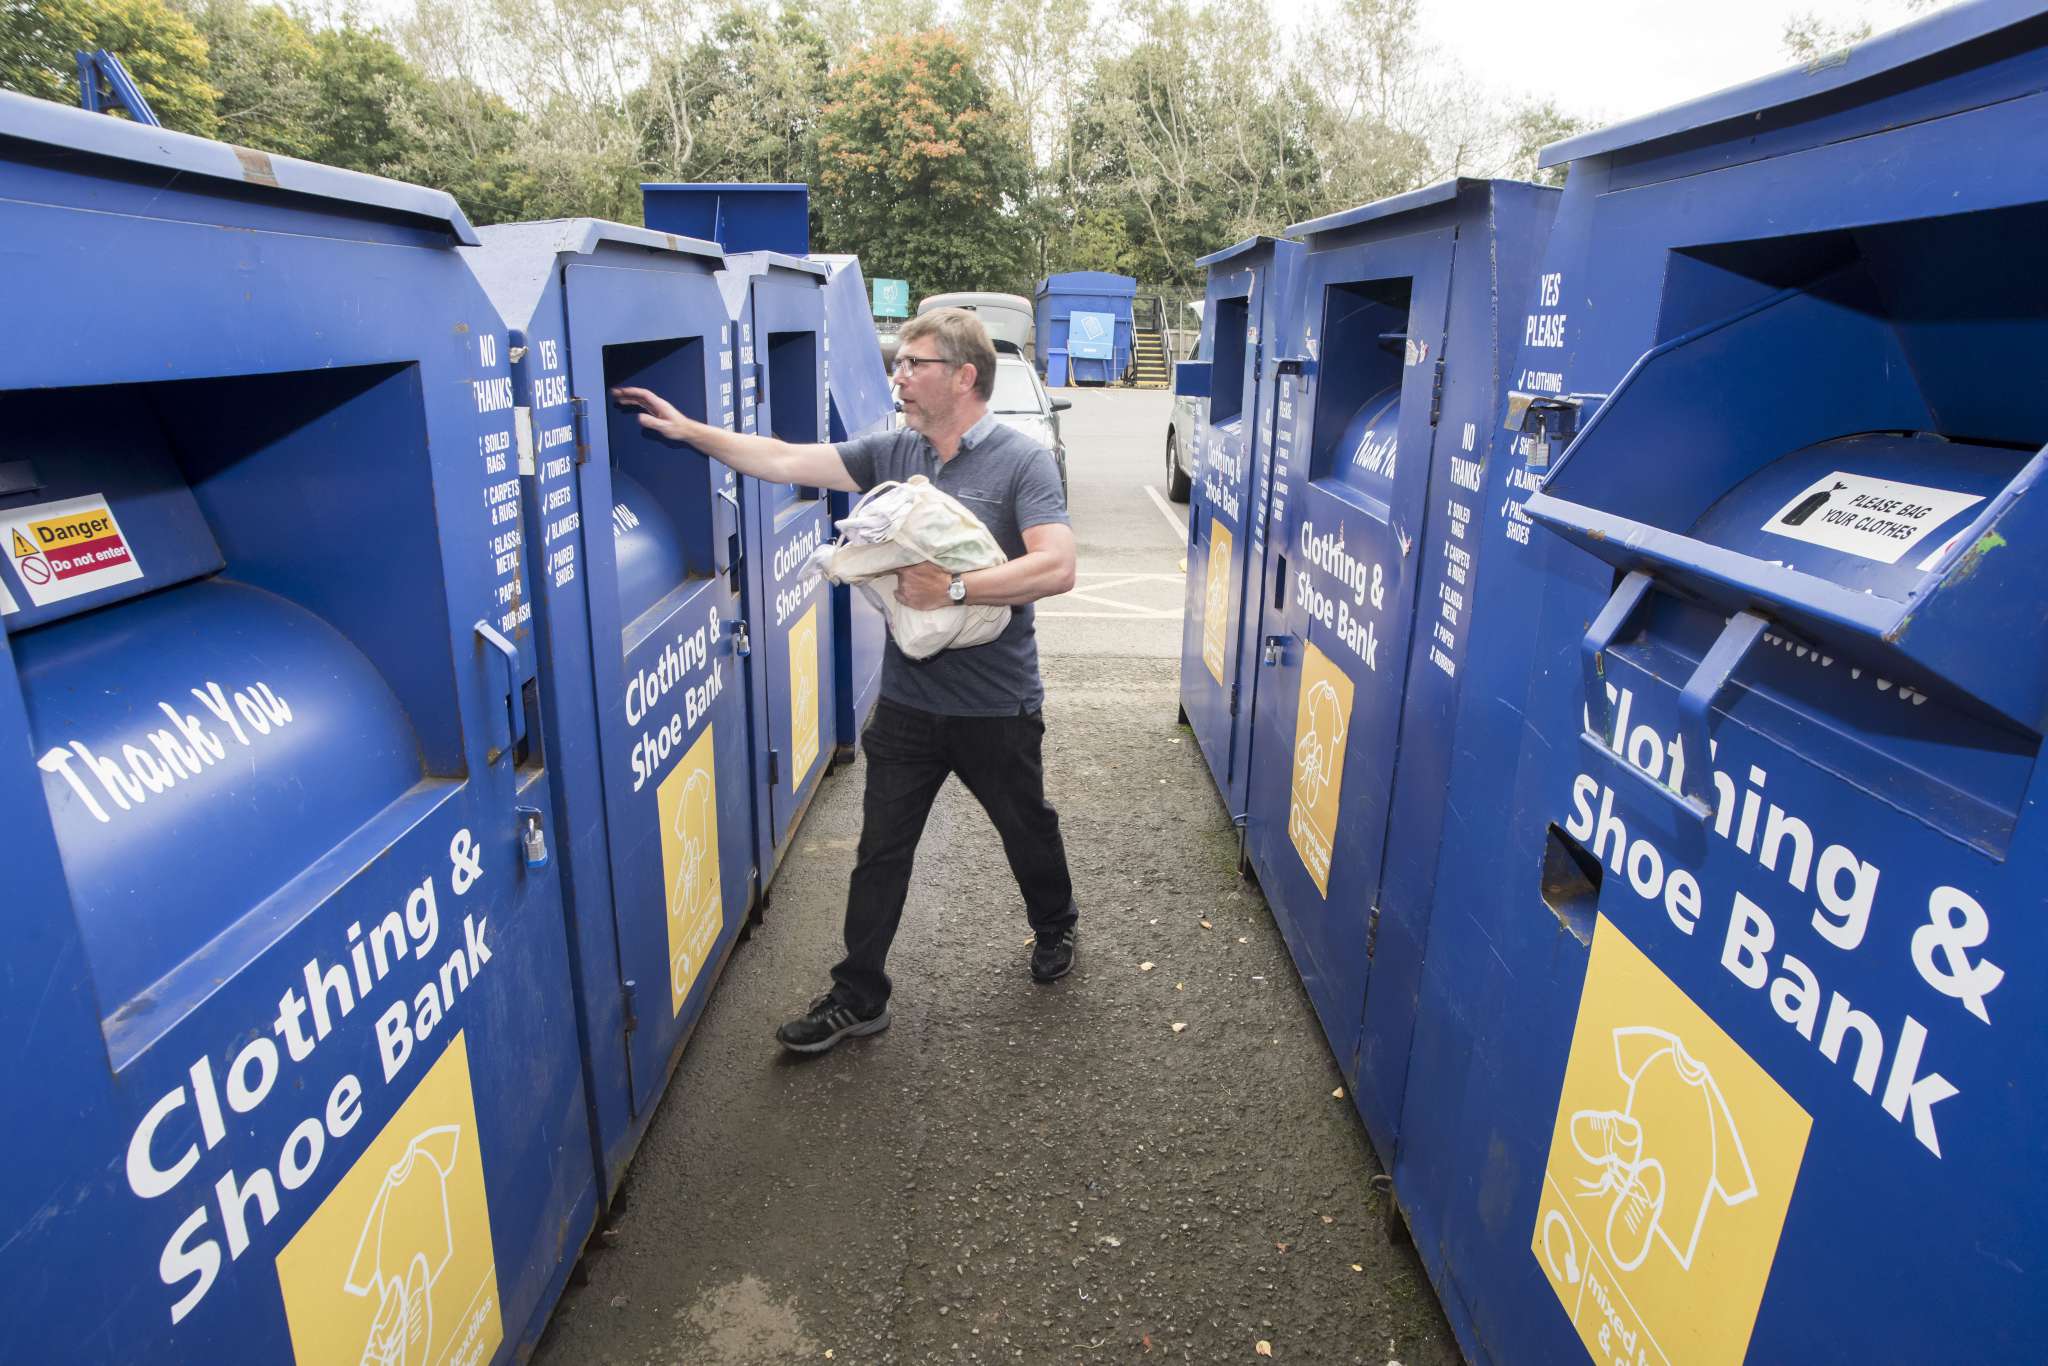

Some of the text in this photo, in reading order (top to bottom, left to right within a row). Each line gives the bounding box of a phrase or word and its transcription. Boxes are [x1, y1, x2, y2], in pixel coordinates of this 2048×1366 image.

[1540, 272, 1561, 307] YES
[1525, 314, 1567, 348] PLEASE
[479, 333, 497, 368] NO
[539, 339, 557, 371] YES
[534, 375, 568, 410] PLEASE
[1527, 370, 1562, 393] CLOTHING
[485, 431, 510, 454] SOILED
[544, 424, 573, 449] CLOTHING
[1462, 422, 1475, 452] NO
[486, 452, 506, 476] RAGS
[547, 455, 571, 479] TOWELS
[1450, 455, 1481, 493] THANKS
[489, 478, 520, 505] CARPETS
[549, 486, 571, 510] SHEETS
[1223, 484, 1239, 523] Bank
[1848, 493, 1932, 520] PLEASE BAG
[491, 500, 518, 526] & RUGS
[551, 511, 580, 540] BLANKETS
[1453, 502, 1471, 524] SOILED
[1821, 508, 1917, 540] YOUR CLOTHES
[37, 517, 109, 543] Danger
[1451, 519, 1465, 540] RAGS
[1506, 520, 1530, 545] SHOES
[50, 546, 127, 572] Do not enter
[496, 551, 520, 576] METAL
[553, 544, 574, 570] PAIRED
[774, 518, 821, 582] Clothing &
[1301, 520, 1367, 607] Clothing
[1370, 563, 1385, 611] &
[555, 562, 575, 588] SHOES
[776, 583, 801, 627] Shoe
[1297, 569, 1379, 672] Shoe Bank
[625, 605, 721, 727] Clothing &
[631, 656, 724, 793] Shoe Bank
[36, 681, 293, 824] Thank You
[1565, 773, 1960, 1160] Shoe Bank
[1911, 885, 2005, 1027] &
[125, 827, 485, 1200] Clothing &
[158, 913, 494, 1327] Shoe Bank
[1587, 1272, 1637, 1358] mixed
[1598, 1322, 1611, 1359] &
